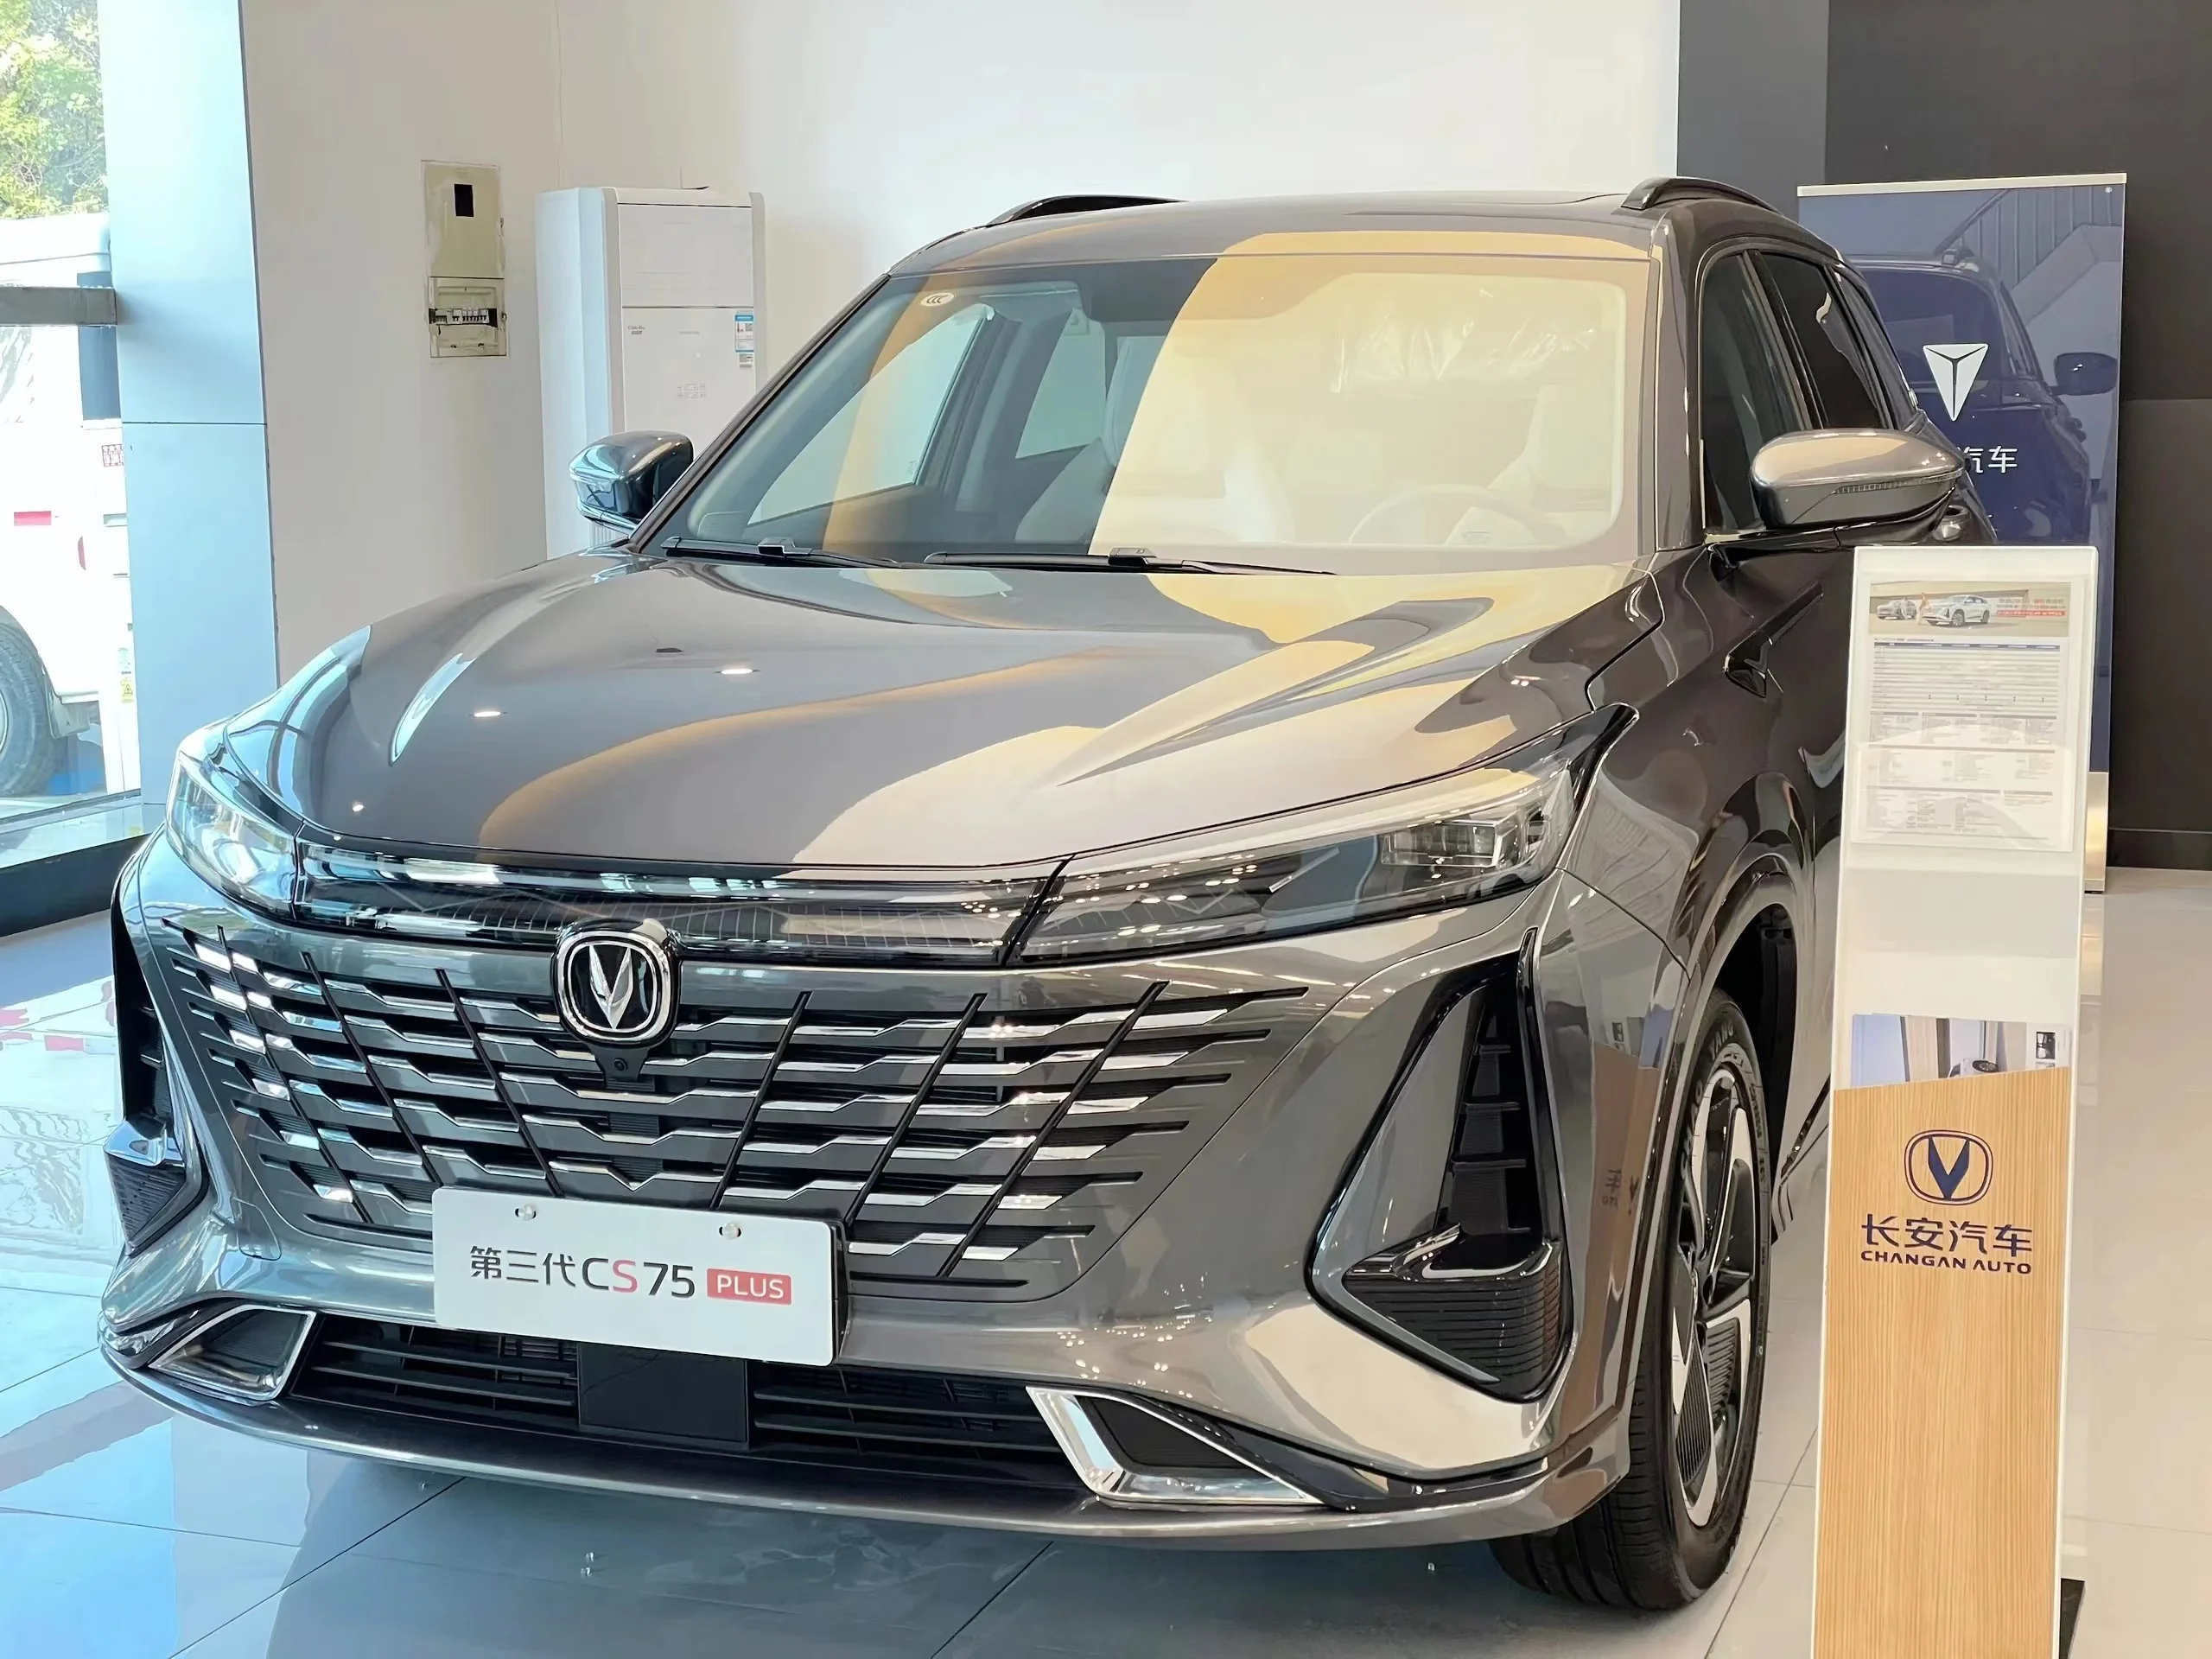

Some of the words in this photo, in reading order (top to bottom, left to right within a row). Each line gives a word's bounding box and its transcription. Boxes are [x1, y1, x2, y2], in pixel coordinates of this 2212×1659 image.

[1861, 1213, 2032, 1257] 长安汽车
[1860, 1250, 1967, 1269] CHANGAN
[1973, 1259, 2032, 1274] AUTO
[715, 1274, 785, 1300] PLUS
